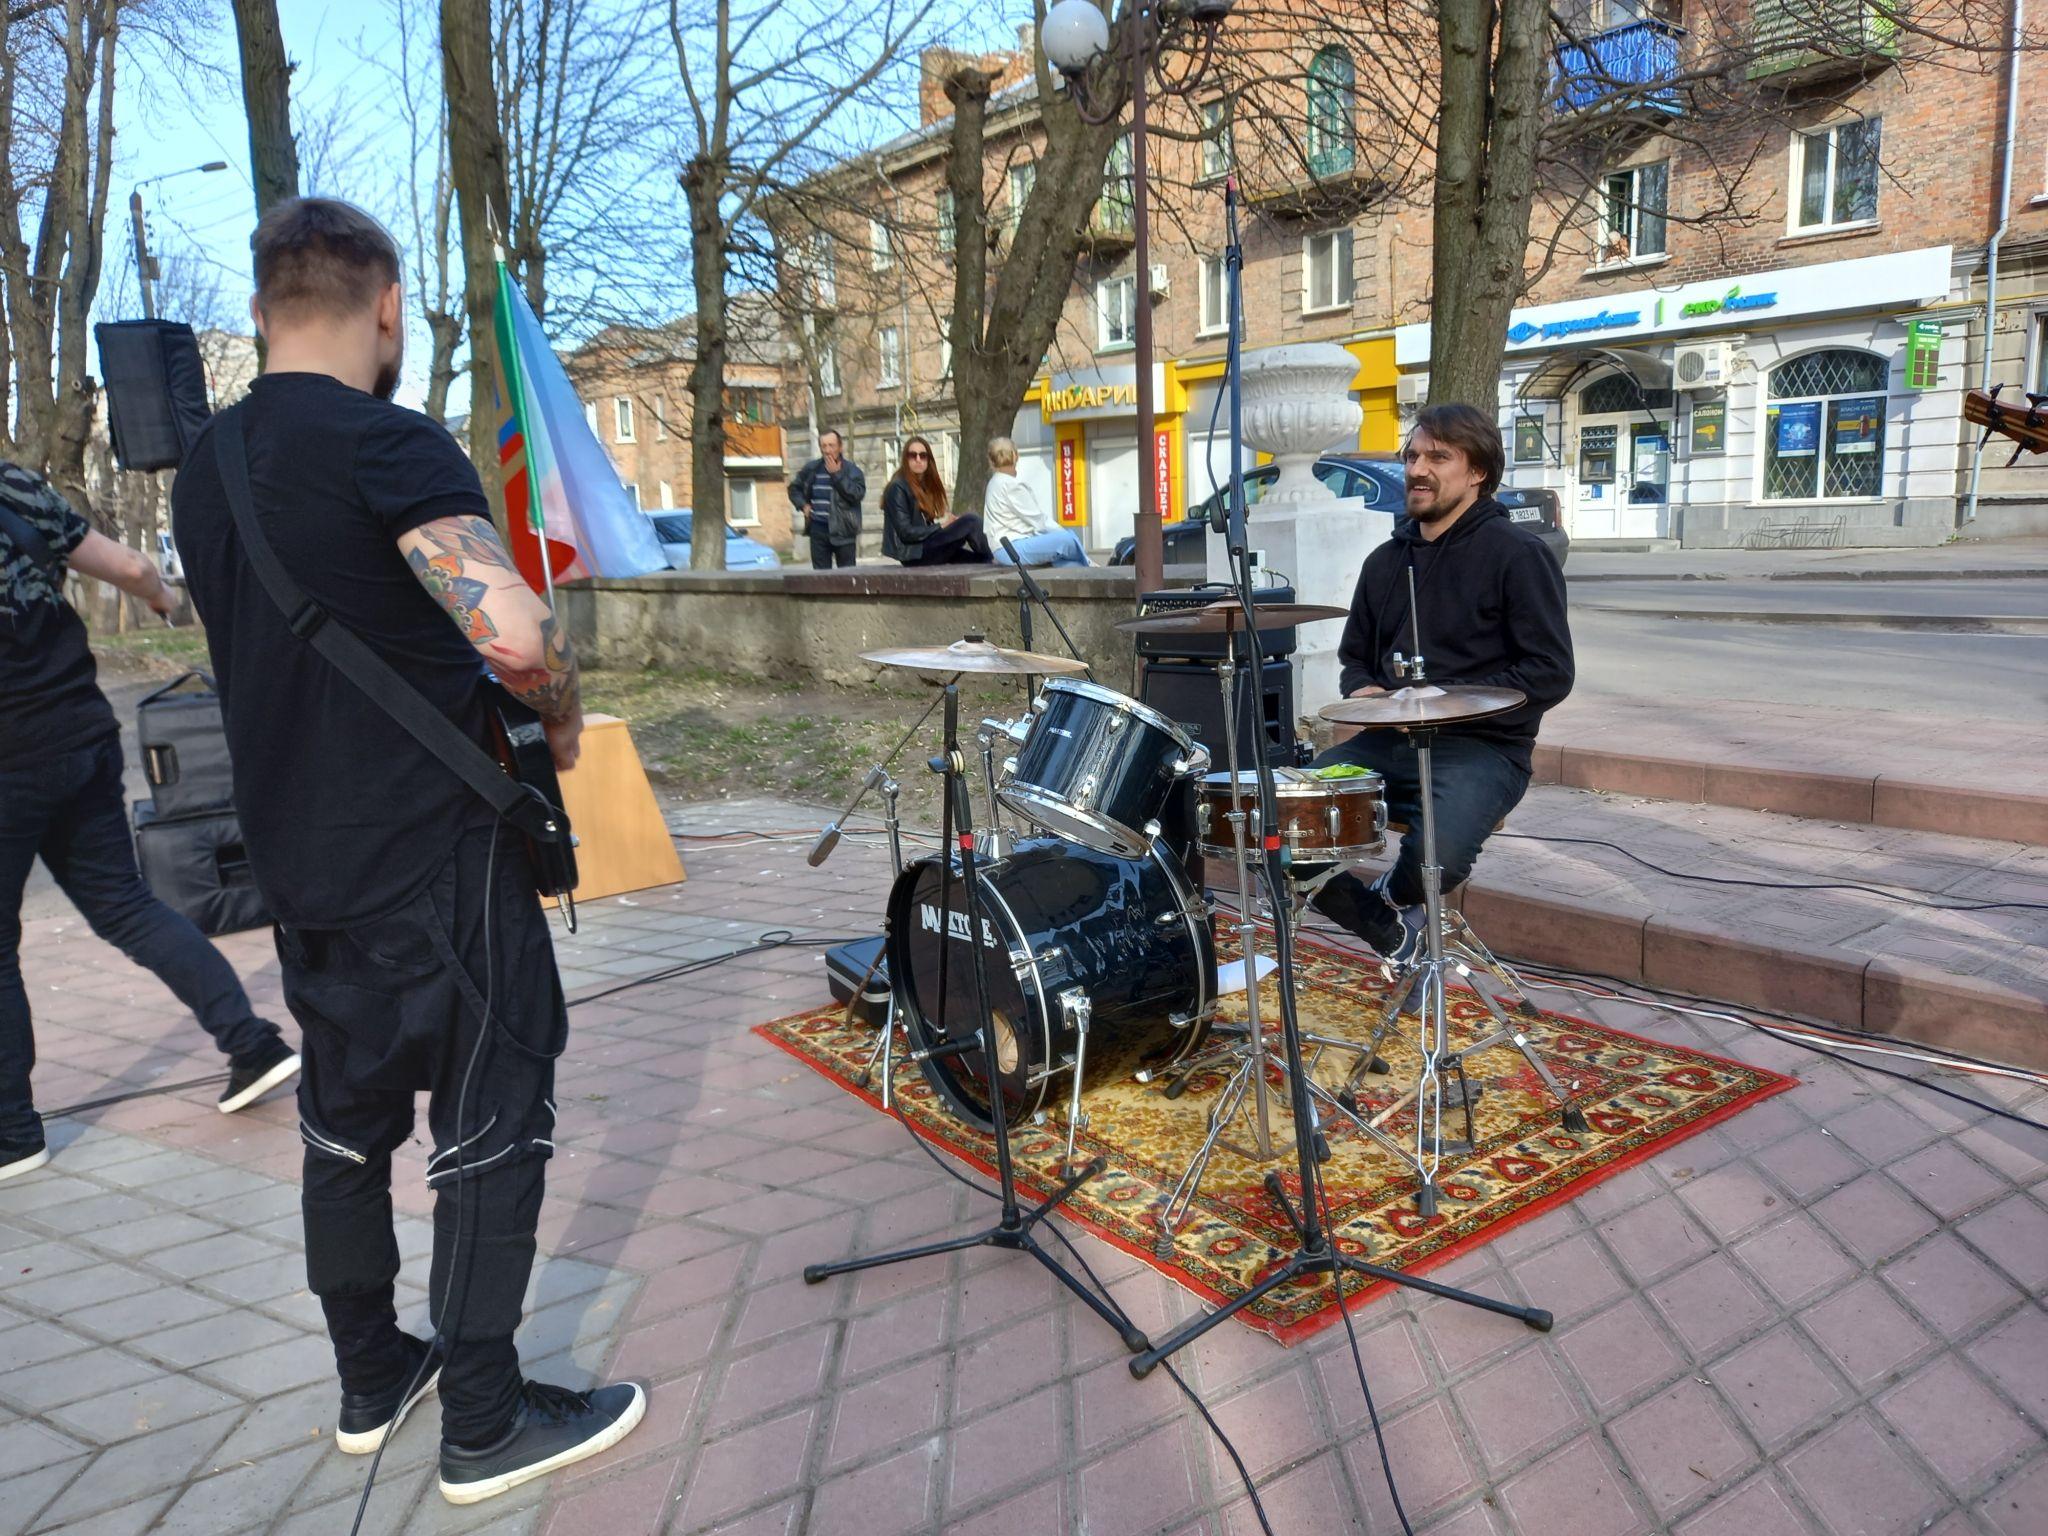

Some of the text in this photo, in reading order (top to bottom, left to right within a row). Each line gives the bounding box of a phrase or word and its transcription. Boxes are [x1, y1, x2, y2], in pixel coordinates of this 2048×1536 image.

[1062, 445, 1074, 515] ВЗУТТЯ
[1158, 434, 1168, 517] СКАРЛЕТ
[921, 904, 992, 943] MXTOE
